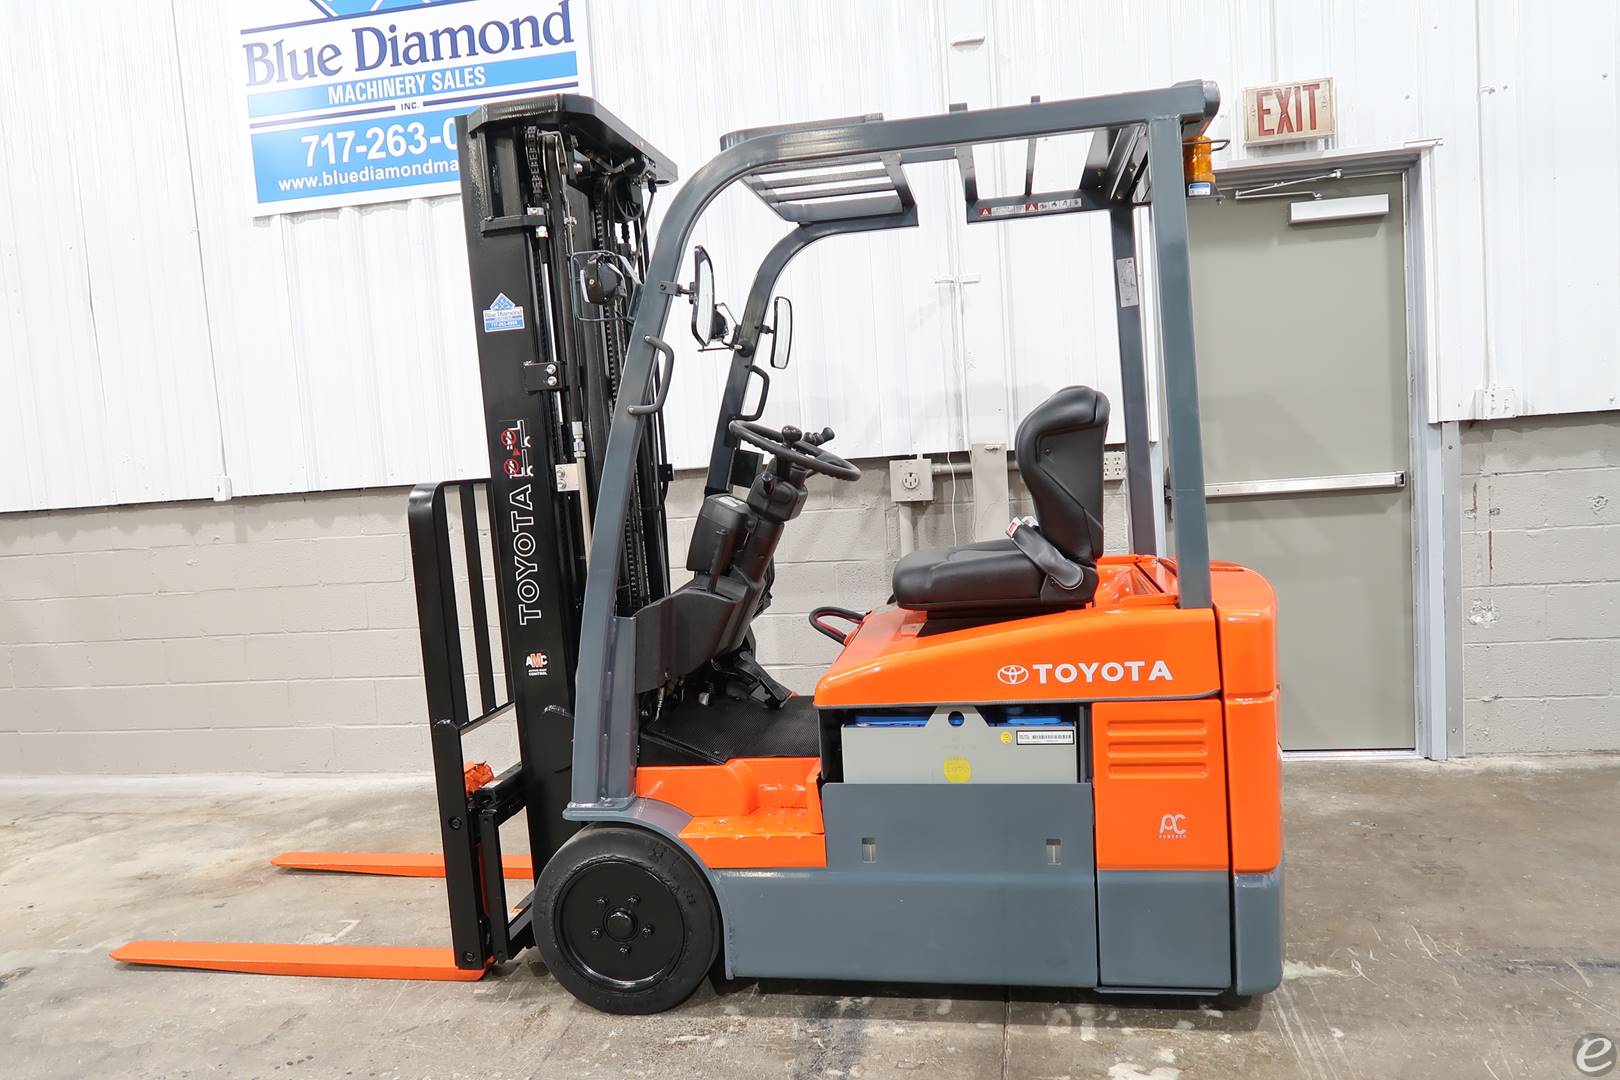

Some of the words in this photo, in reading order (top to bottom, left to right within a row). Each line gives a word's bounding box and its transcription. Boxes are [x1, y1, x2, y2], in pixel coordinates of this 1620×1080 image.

[242, 38, 343, 87] Blue
[352, 0, 574, 72] Diamond
[327, 73, 427, 105] MACHINERY
[431, 66, 486, 92] SALES
[401, 101, 420, 111] INC.
[1256, 83, 1320, 137] EXIT
[509, 483, 542, 626] TOYOTA
[1032, 660, 1173, 684] TOYOTA
[1159, 813, 1186, 835] AC
